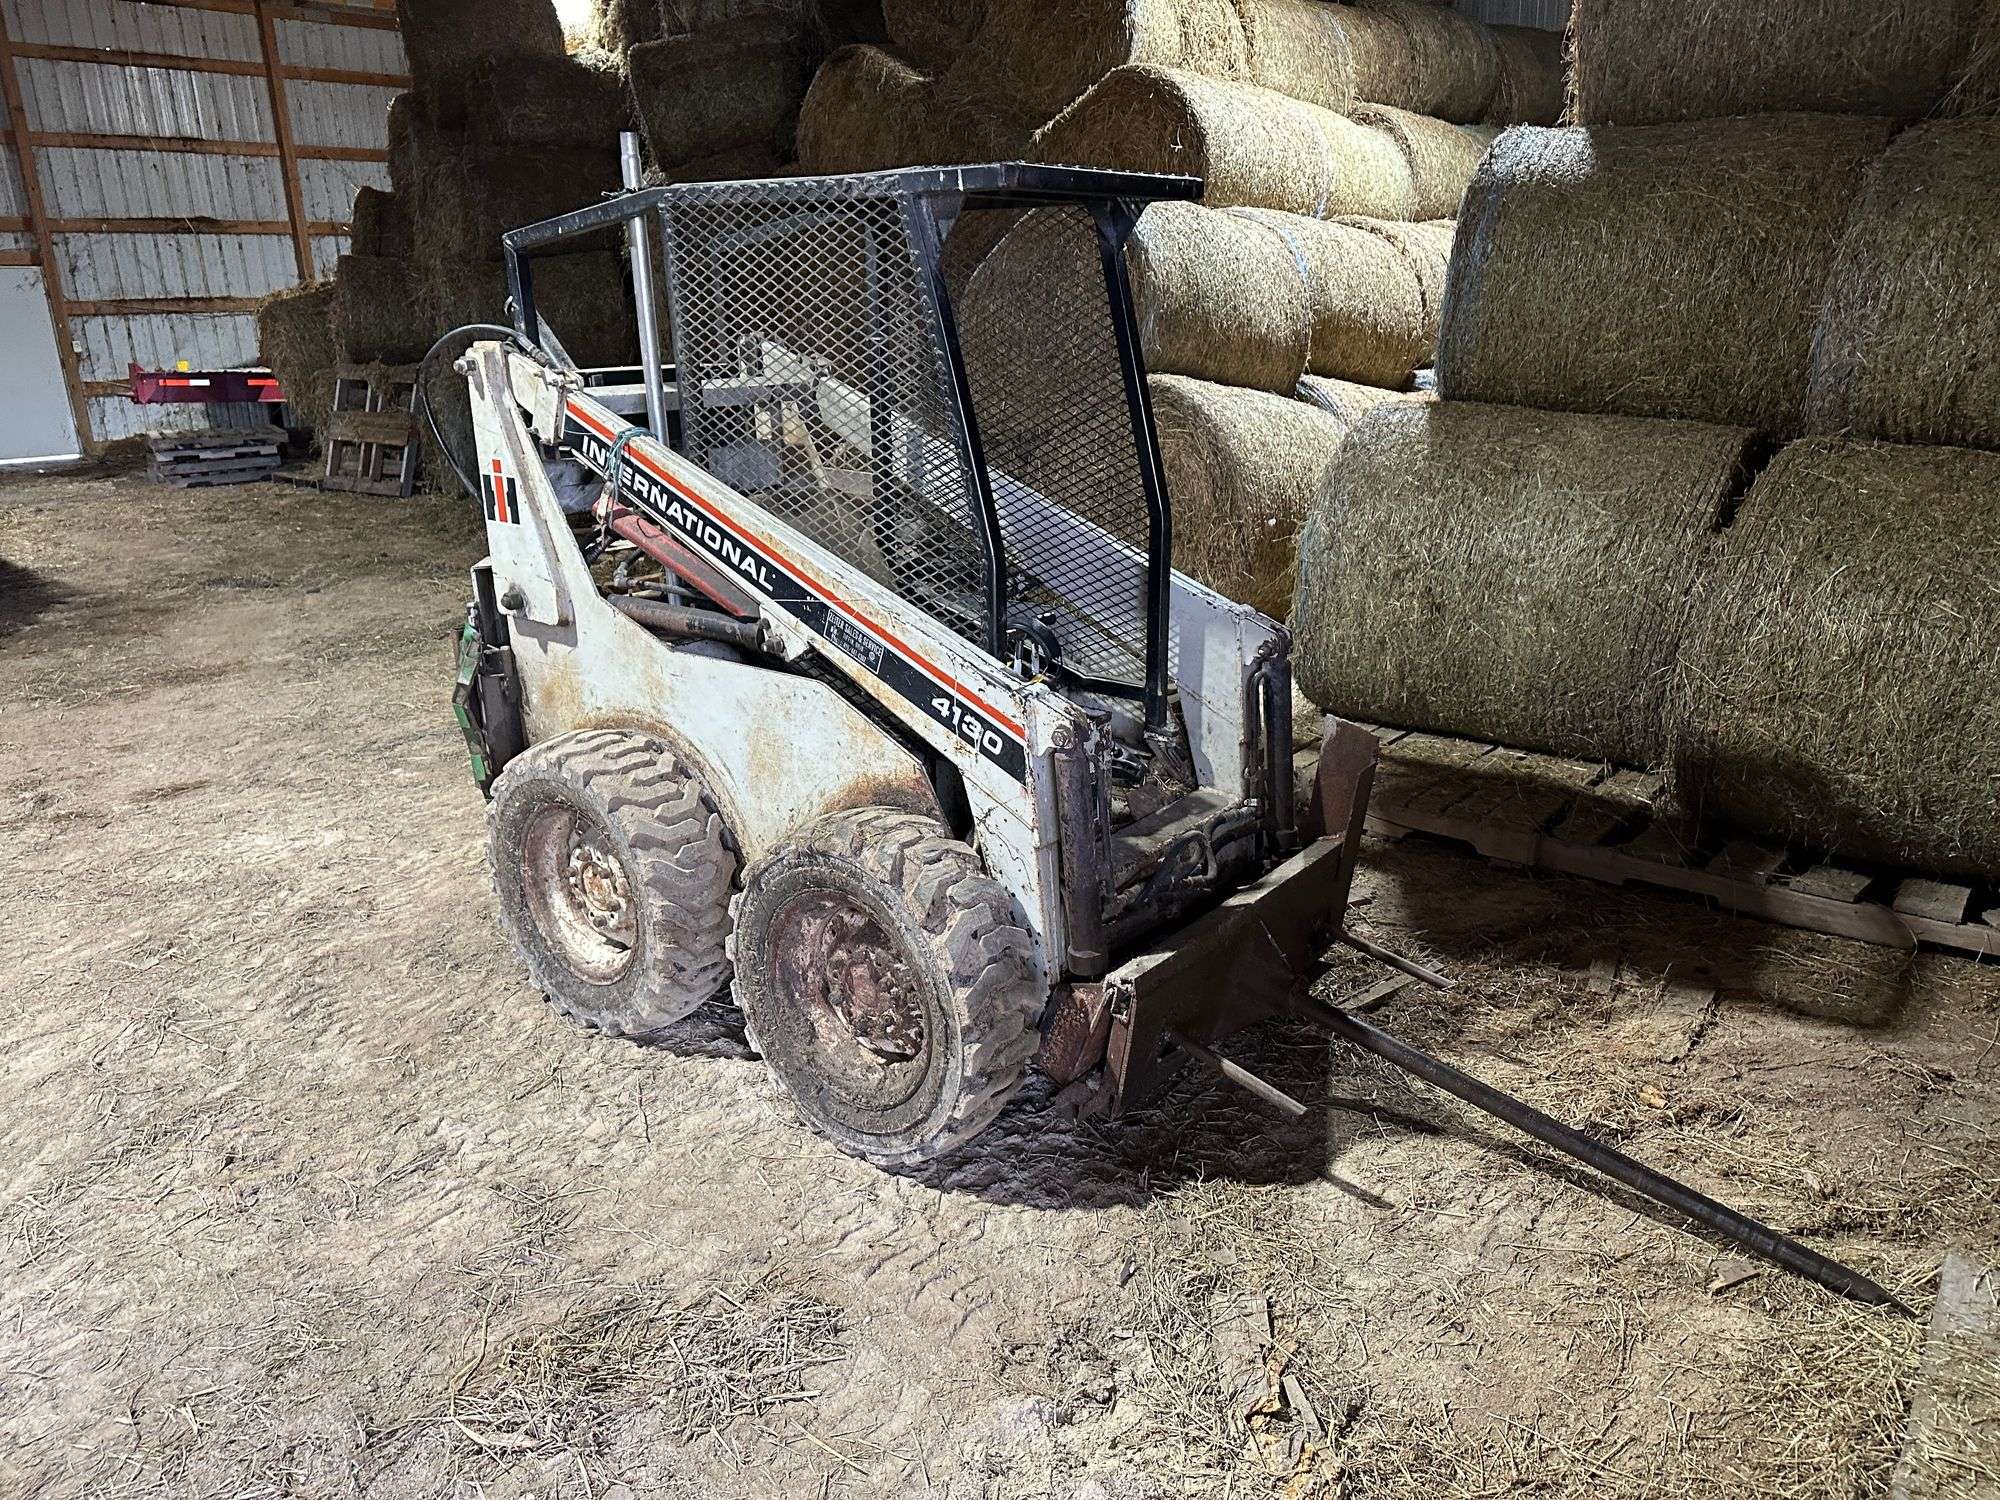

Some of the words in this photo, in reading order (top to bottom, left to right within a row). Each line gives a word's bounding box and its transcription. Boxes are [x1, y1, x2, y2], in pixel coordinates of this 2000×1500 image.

[582, 435, 774, 592] INERNATIONAL
[863, 637, 881, 656] SERVICE
[931, 698, 1003, 755] 4130
